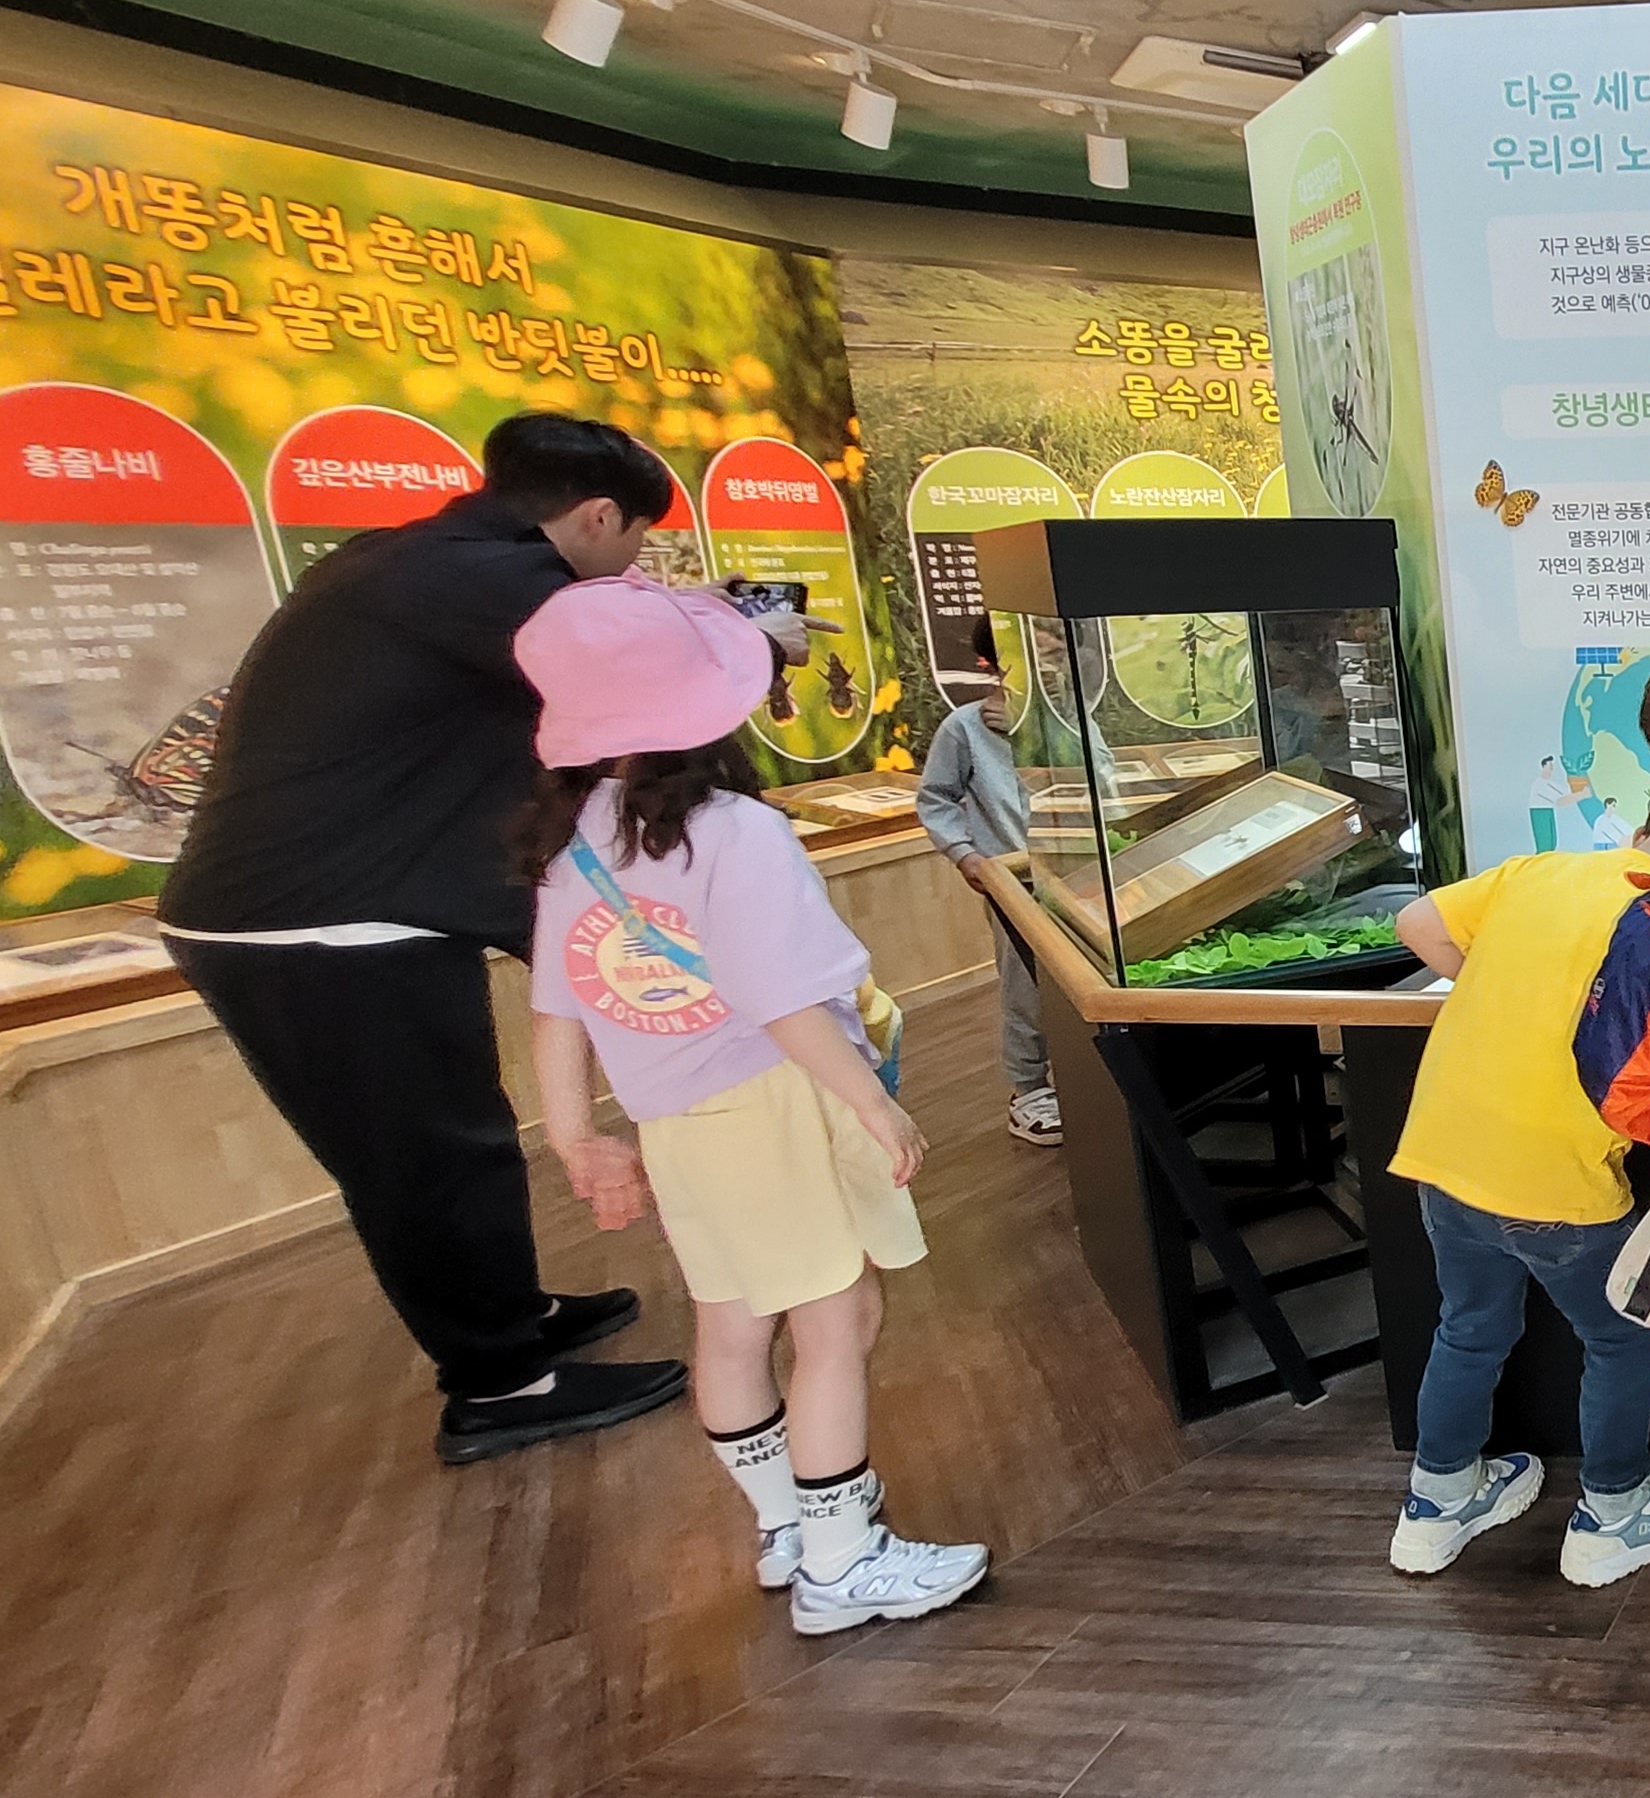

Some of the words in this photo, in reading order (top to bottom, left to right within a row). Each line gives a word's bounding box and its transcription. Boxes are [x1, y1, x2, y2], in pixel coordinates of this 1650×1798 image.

[1503, 71, 1581, 120] 다음
[1487, 133, 1602, 180] 우리의
[55, 165, 353, 273] 개똥처럼
[369, 213, 533, 294] 흔해서
[1539, 237, 1569, 256] 지구
[1573, 236, 1620, 255] 온난화
[1550, 266, 1611, 285] 지구상의
[0, 250, 260, 334] 레라고
[270, 278, 458, 364] 불리던
[1551, 295, 1597, 315] 것으로
[1075, 320, 1199, 367] 소똥을
[1119, 374, 1240, 419] 물속의
[22, 445, 161, 481] 홍줄나비
[291, 457, 471, 492] 깊은산부전나비
[724, 477, 821, 504] 참호박뒤영벌
[927, 486, 1058, 507] 한국꼬마잠자리
[1110, 488, 1225, 507] 노란잔산잠자리
[1552, 503, 1610, 521] 전문기관
[1568, 530, 1640, 548] 멸종위기에
[1539, 557, 1582, 575] 자연의
[1586, 556, 1645, 574] 중요성과
[1571, 584, 1600, 601] 우리
